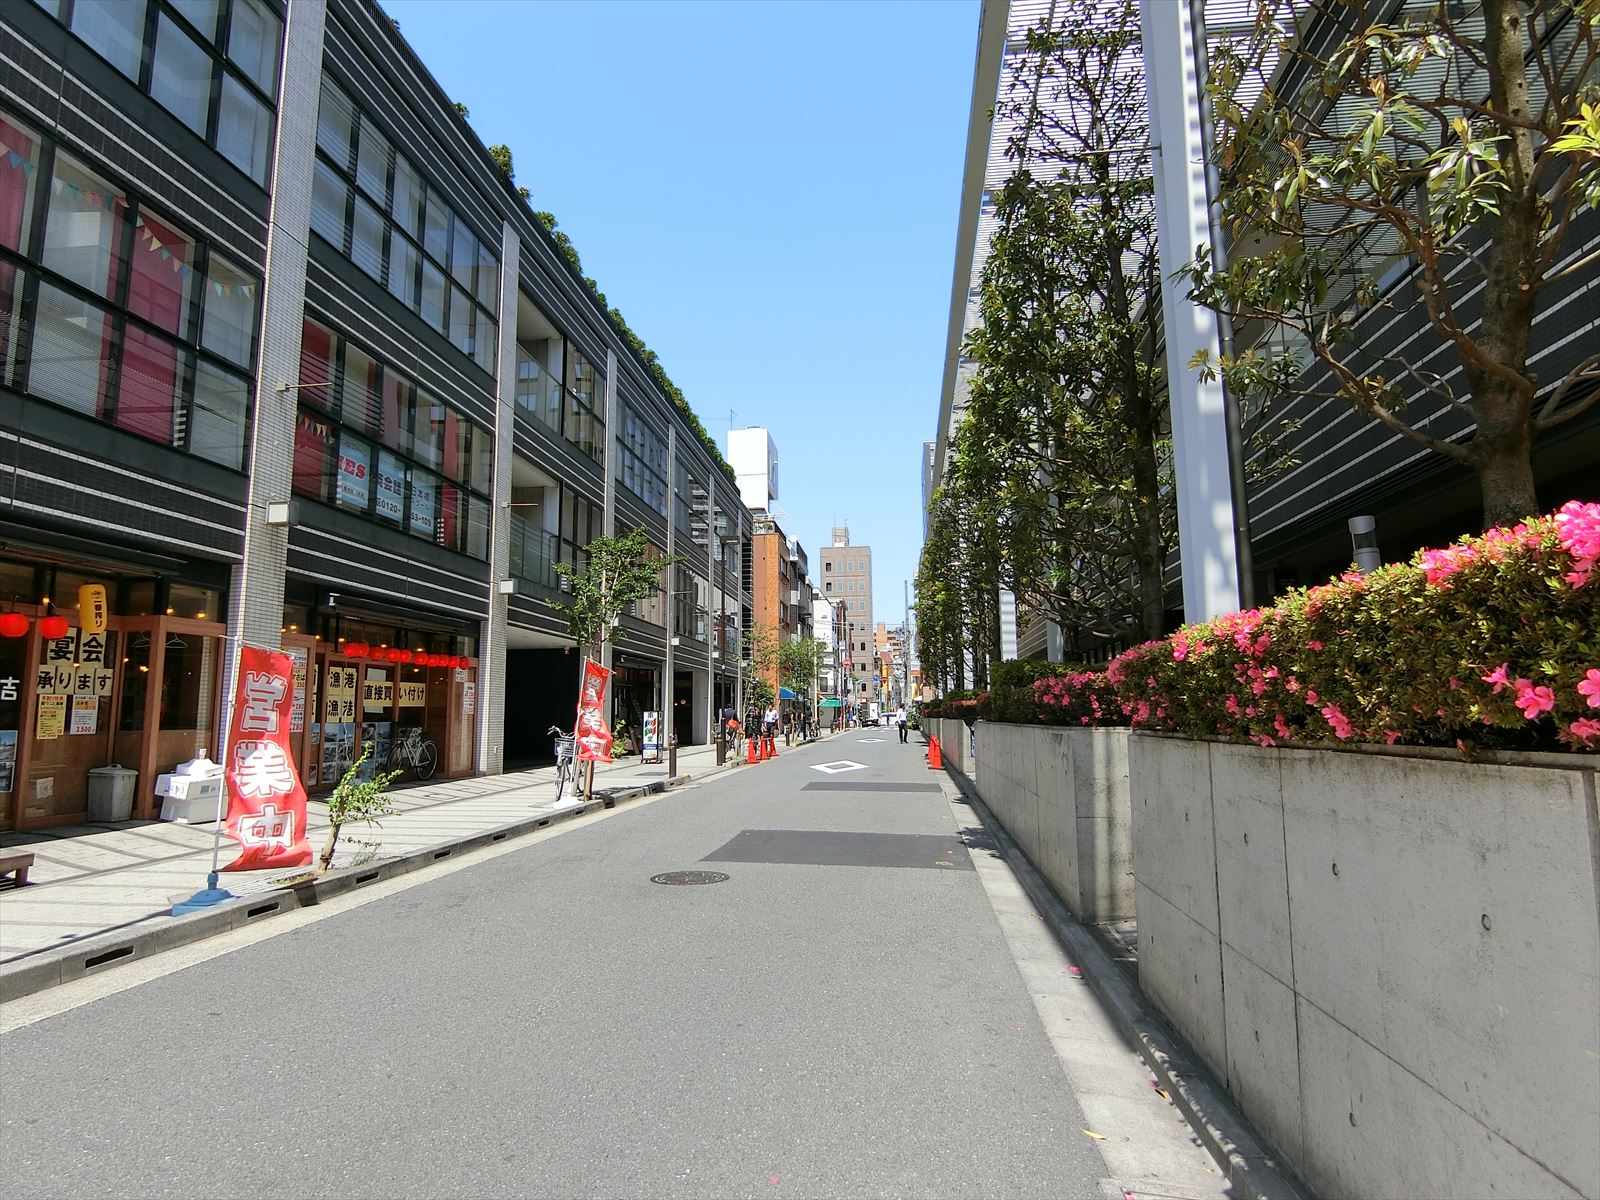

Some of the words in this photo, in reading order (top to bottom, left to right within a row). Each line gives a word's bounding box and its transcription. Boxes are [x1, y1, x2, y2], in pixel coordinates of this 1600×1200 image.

[50, 634, 104, 662] 宴会
[38, 671, 112, 690] 承ります
[234, 671, 295, 857] 営業中
